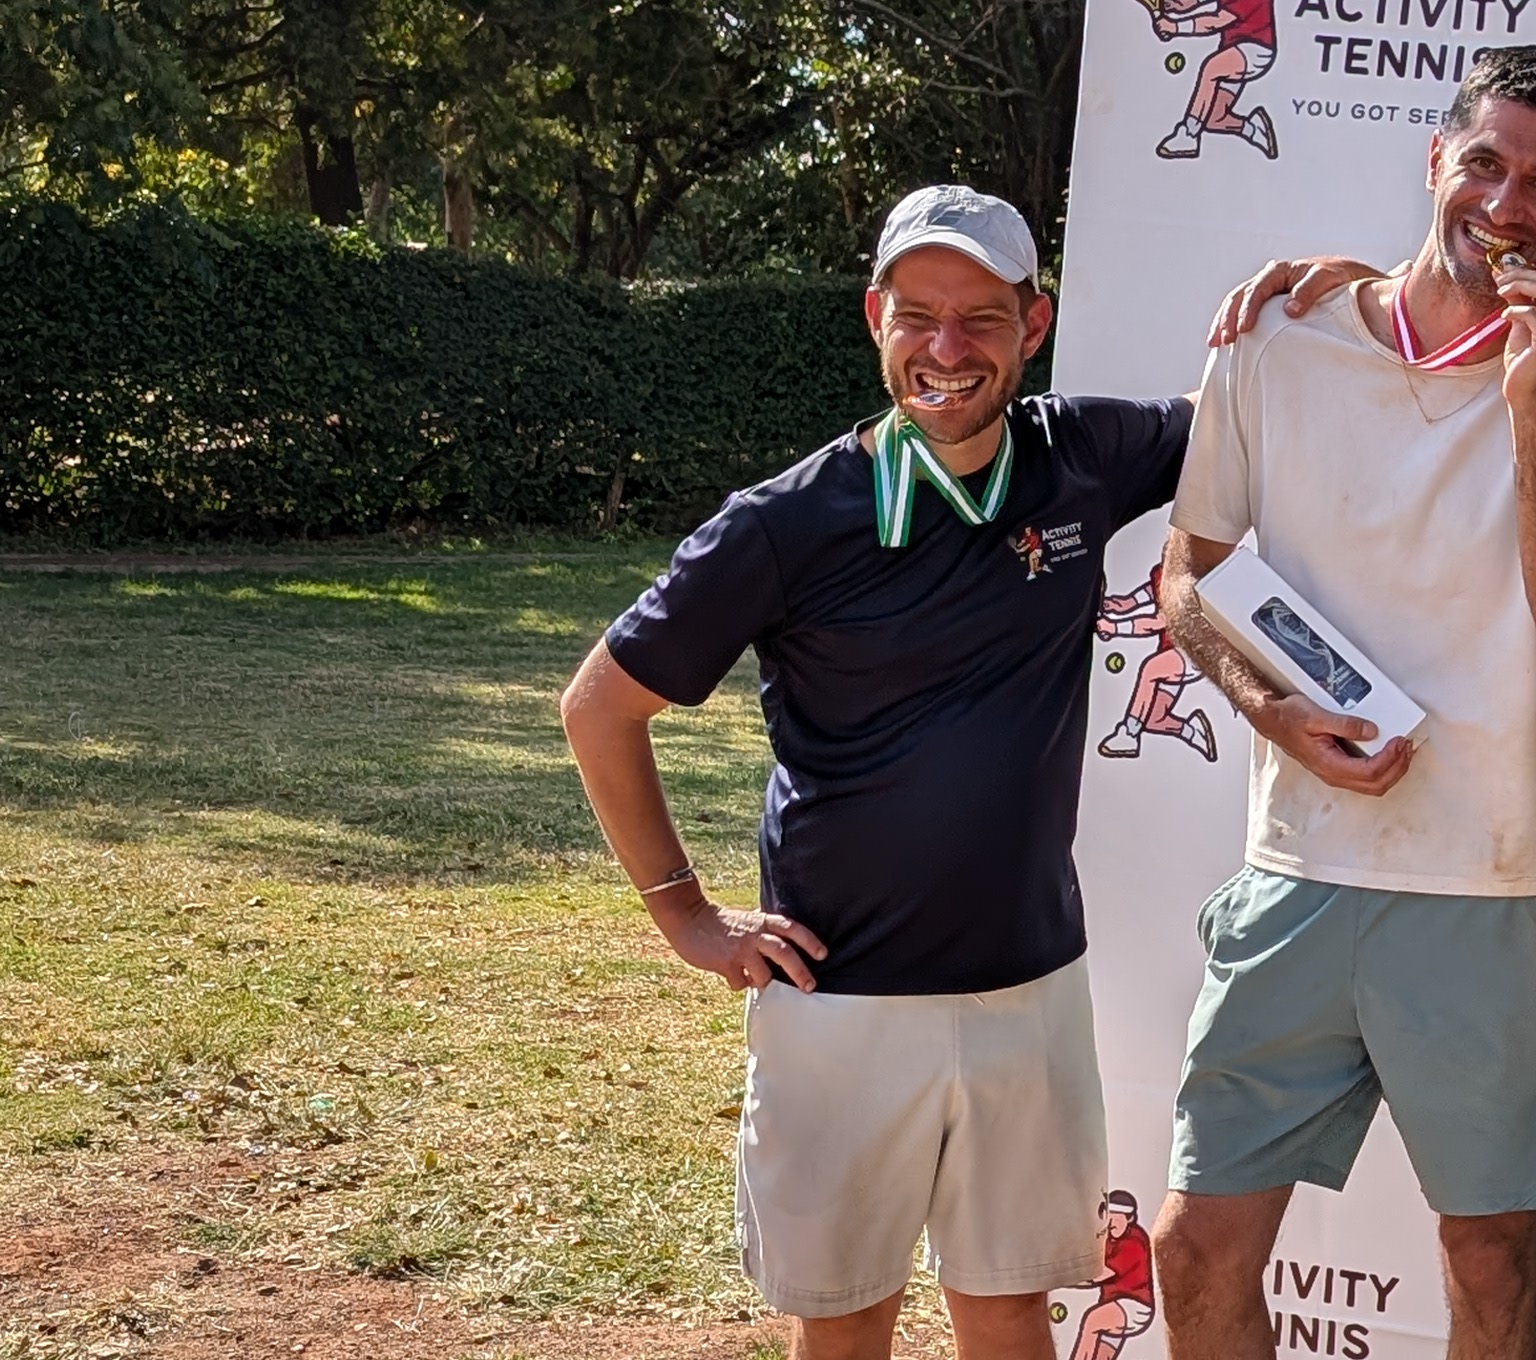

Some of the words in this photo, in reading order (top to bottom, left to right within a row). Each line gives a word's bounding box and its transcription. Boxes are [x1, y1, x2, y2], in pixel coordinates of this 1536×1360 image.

[1314, 34, 1492, 83] TENNI
[1292, 98, 1340, 118] YOU
[1350, 103, 1400, 122] GOT
[1272, 1259, 1400, 1313] IVITY
